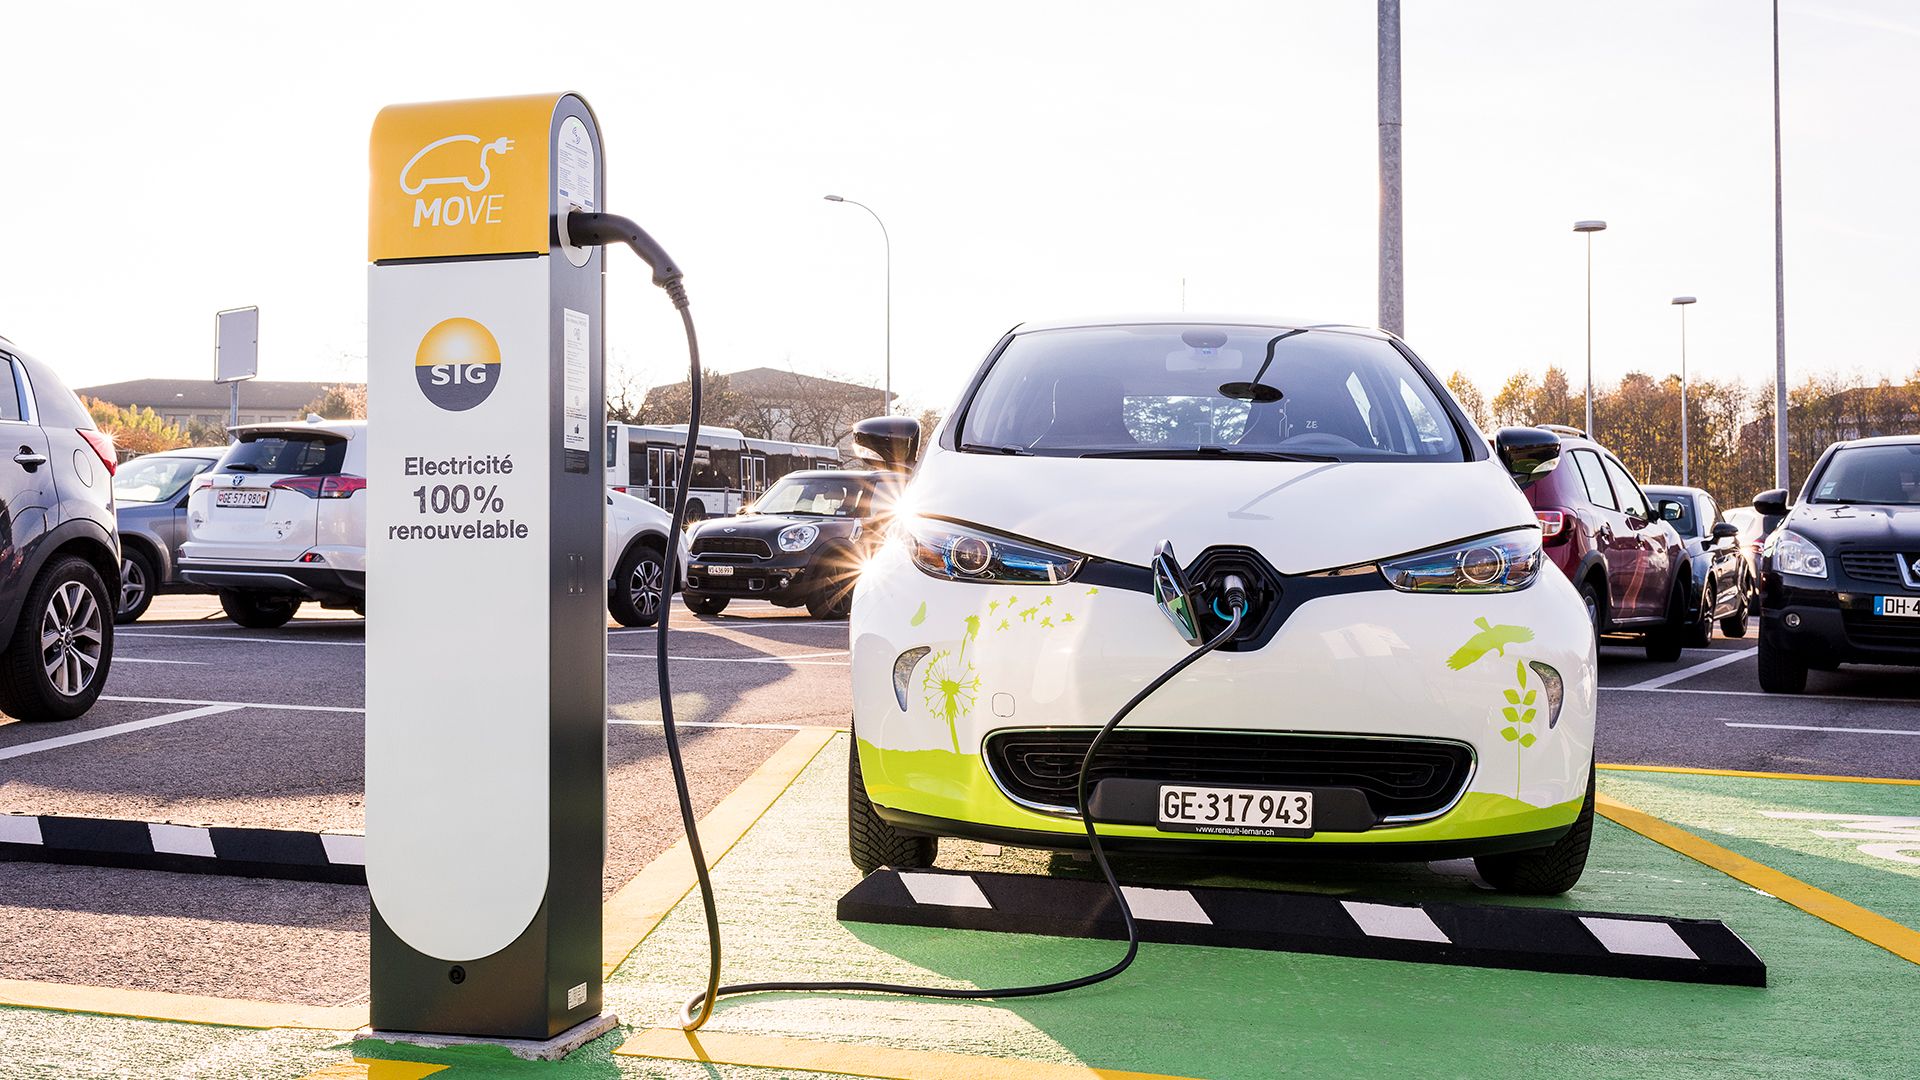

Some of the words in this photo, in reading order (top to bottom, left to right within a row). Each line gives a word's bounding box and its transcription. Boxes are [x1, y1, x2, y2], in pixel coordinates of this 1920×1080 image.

[413, 194, 505, 228] MOVE
[431, 363, 487, 386] SIG
[404, 454, 514, 476] Electricité
[413, 484, 504, 514] 100%
[388, 519, 529, 540] renouvelable
[1195, 826, 1275, 837] www.renault-leman.ch
